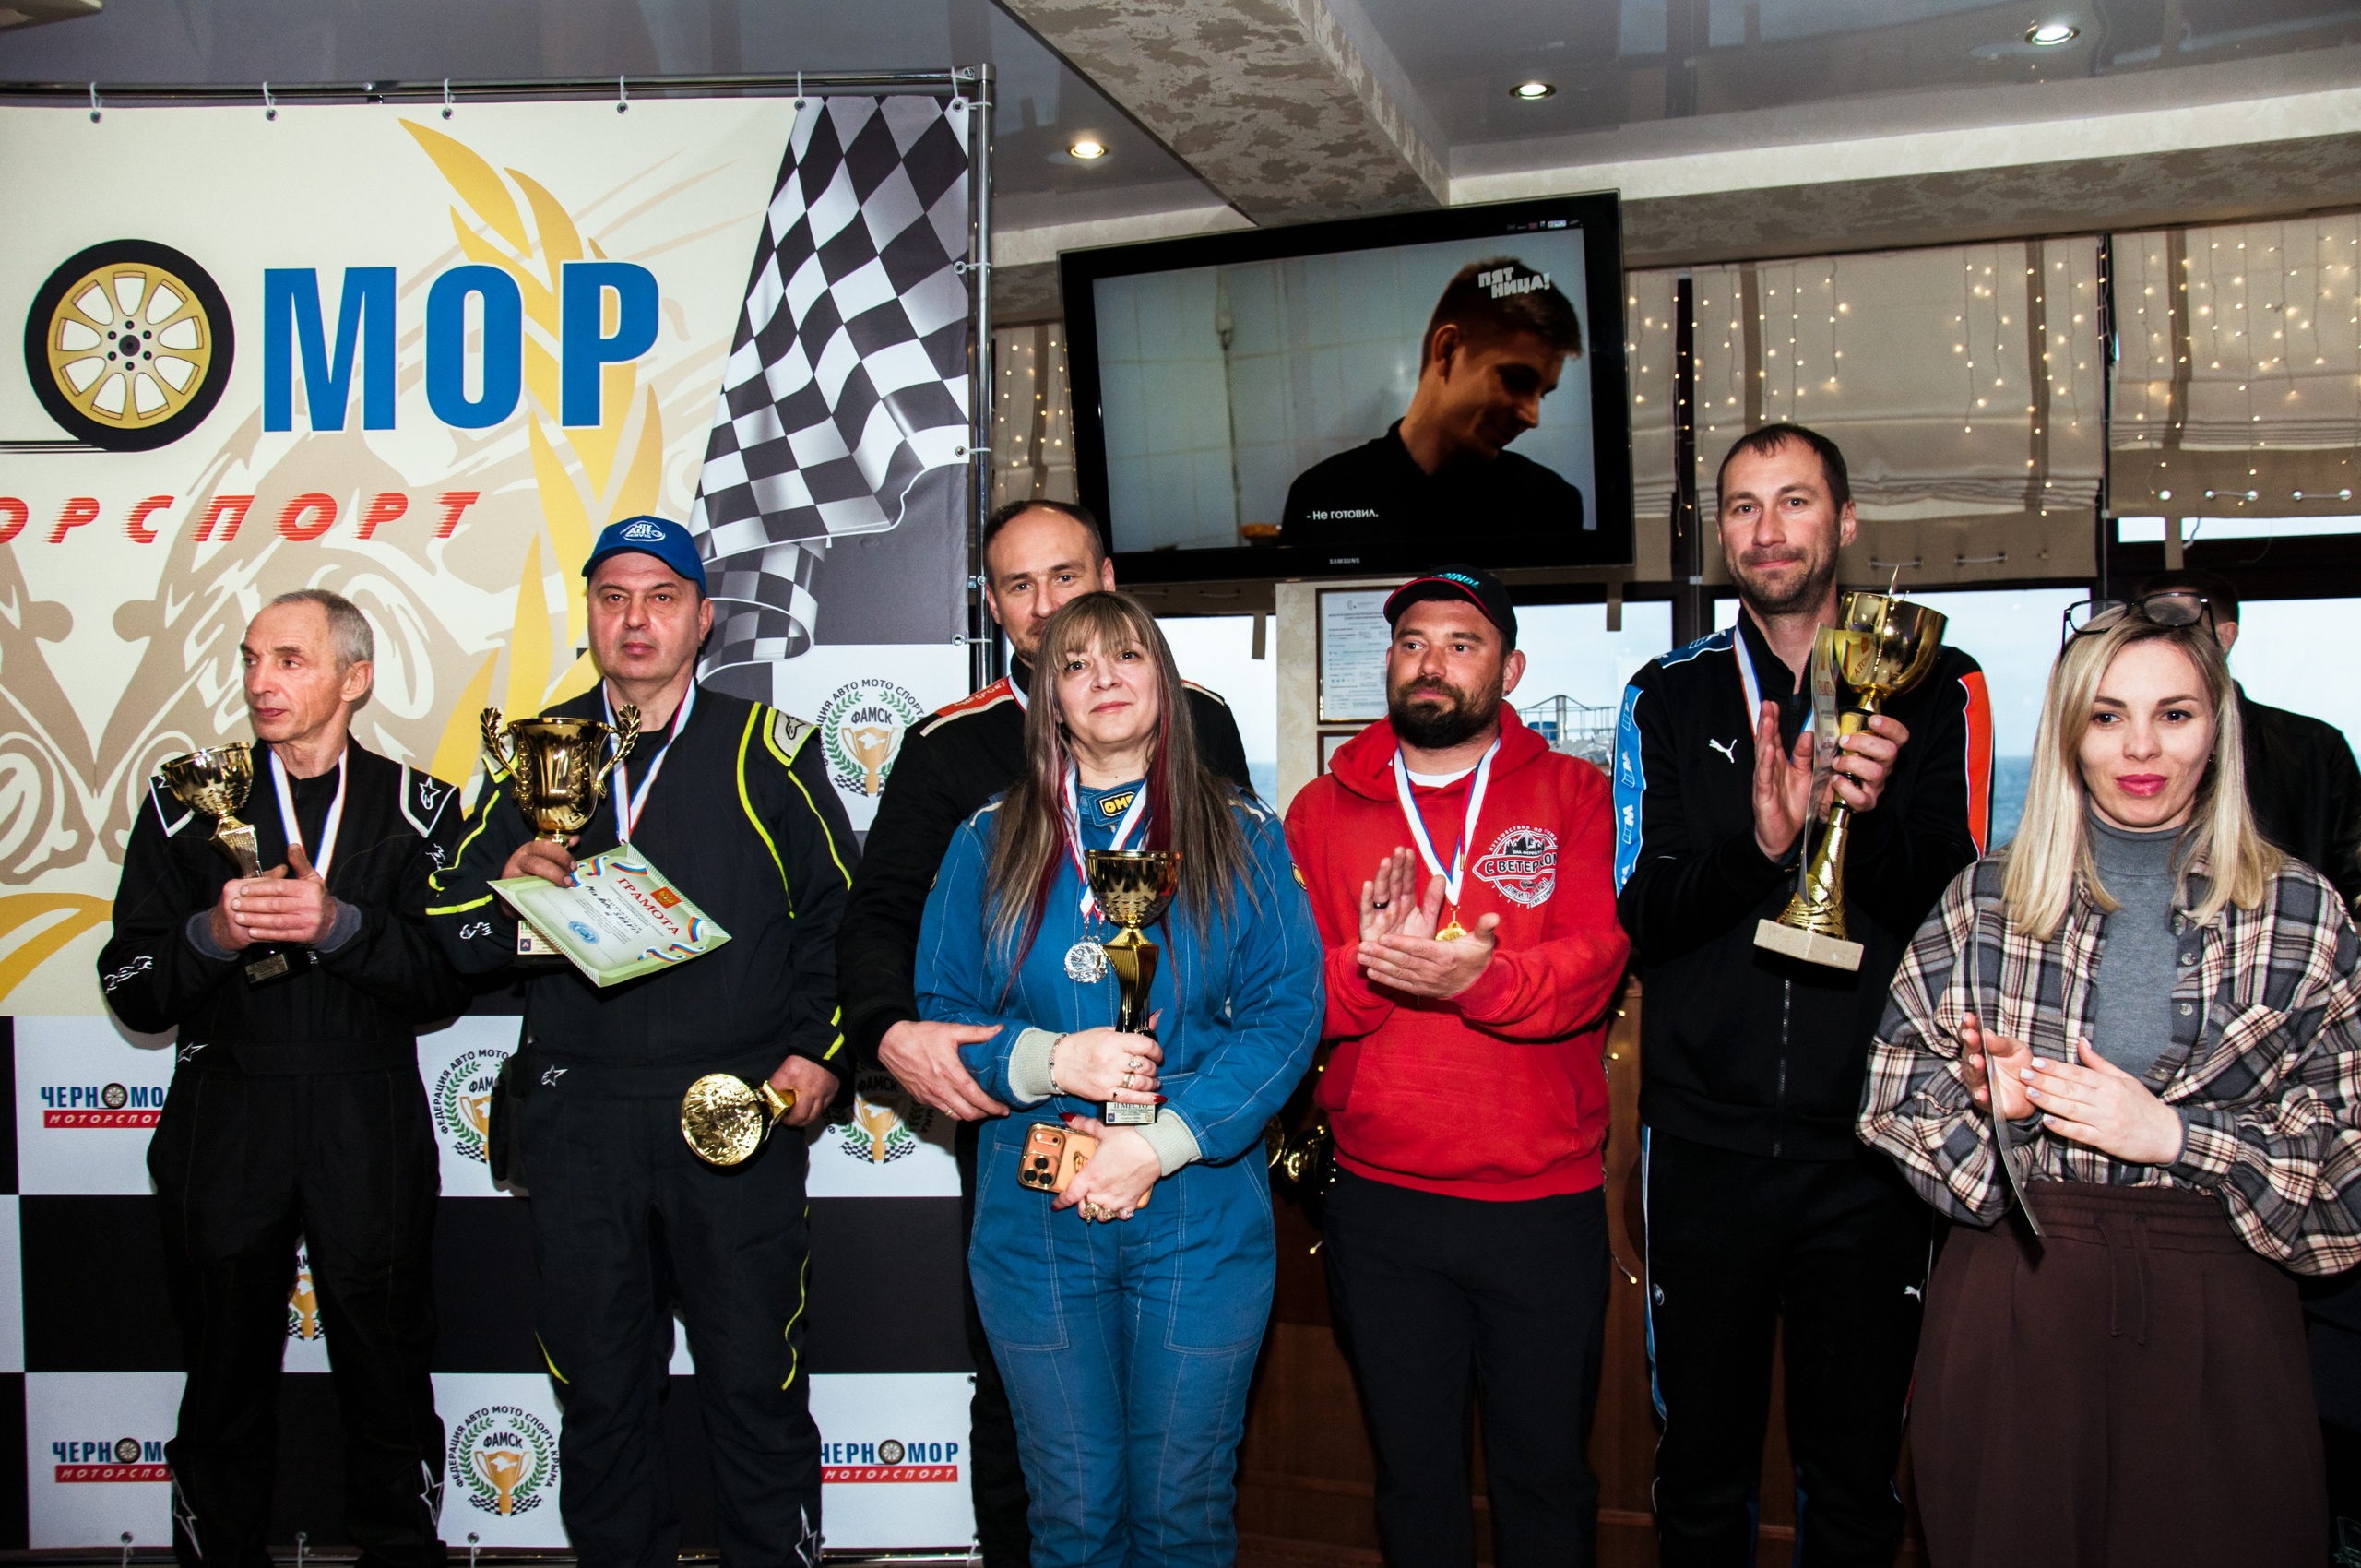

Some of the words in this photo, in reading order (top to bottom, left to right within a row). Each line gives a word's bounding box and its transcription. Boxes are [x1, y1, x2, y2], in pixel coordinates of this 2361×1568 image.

[1478, 267, 1513, 288] ПЯТ
[1491, 272, 1550, 299] НИЦА!
[1312, 510, 1328, 520] Не
[1330, 508, 1379, 520] готовил.
[832, 681, 859, 701] АВТО
[861, 679, 894, 690] МОТО
[896, 686, 925, 719] СПОРТ
[975, 681, 1006, 700] SPORT
[851, 707, 893, 725] ФАМСК
[617, 877, 679, 935] ГРАМОТА
[433, 1069, 452, 1134] ФЕДЕРАЦИЯ
[450, 1051, 476, 1070] АВТО
[478, 1049, 509, 1060] МОТО
[469, 1076, 494, 1093] ФАМ
[447, 1425, 466, 1488] ФЕДЕРАЦИЯ
[464, 1408, 490, 1427] АВТО
[492, 1406, 523, 1417] МОТО
[525, 1413, 556, 1448] СПОРТА
[544, 1450, 560, 1488] КРЫМА
[482, 1431, 524, 1449] ФАМСК
[60, 1468, 167, 1479] МОТОРСПО
[824, 1469, 955, 1479] МОТОРСПОРТ
